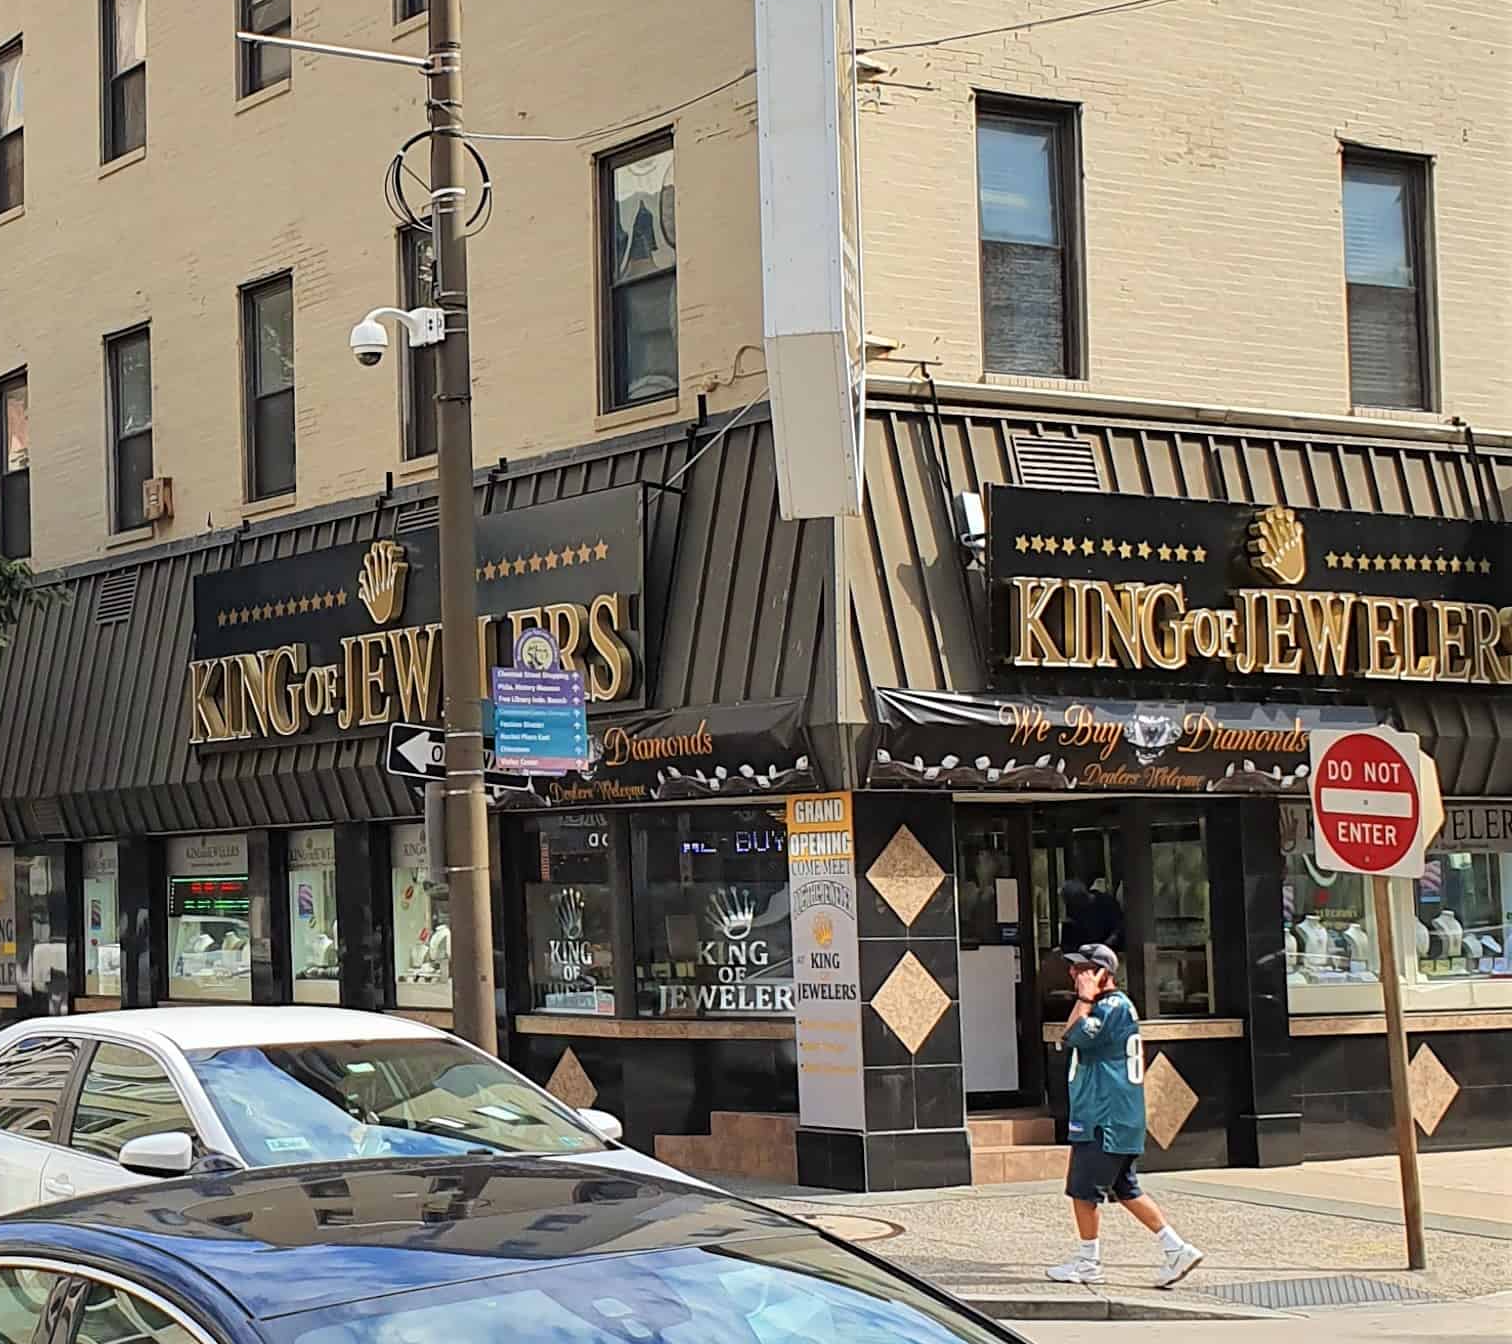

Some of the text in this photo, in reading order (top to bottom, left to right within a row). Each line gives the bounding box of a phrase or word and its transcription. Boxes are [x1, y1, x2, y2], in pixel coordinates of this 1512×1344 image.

[1013, 577, 1512, 684] KING OF JEWELER
[190, 592, 630, 744] KING OF JEWLERS
[604, 719, 712, 767] Diamonds
[999, 704, 1309, 760] We Buy Diamonds
[1327, 759, 1401, 785] DO NOT
[794, 799, 844, 824] GRAND
[1439, 809, 1512, 840] ELER
[790, 831, 851, 857] OPENING
[1337, 821, 1398, 846] ENTER
[549, 940, 592, 965] KING
[696, 940, 769, 966] KING
[810, 952, 840, 970] KING
[563, 965, 580, 981] OF
[717, 966, 747, 984] OF
[658, 984, 796, 1016] JEWELER
[797, 983, 857, 1002] JEWELERS
